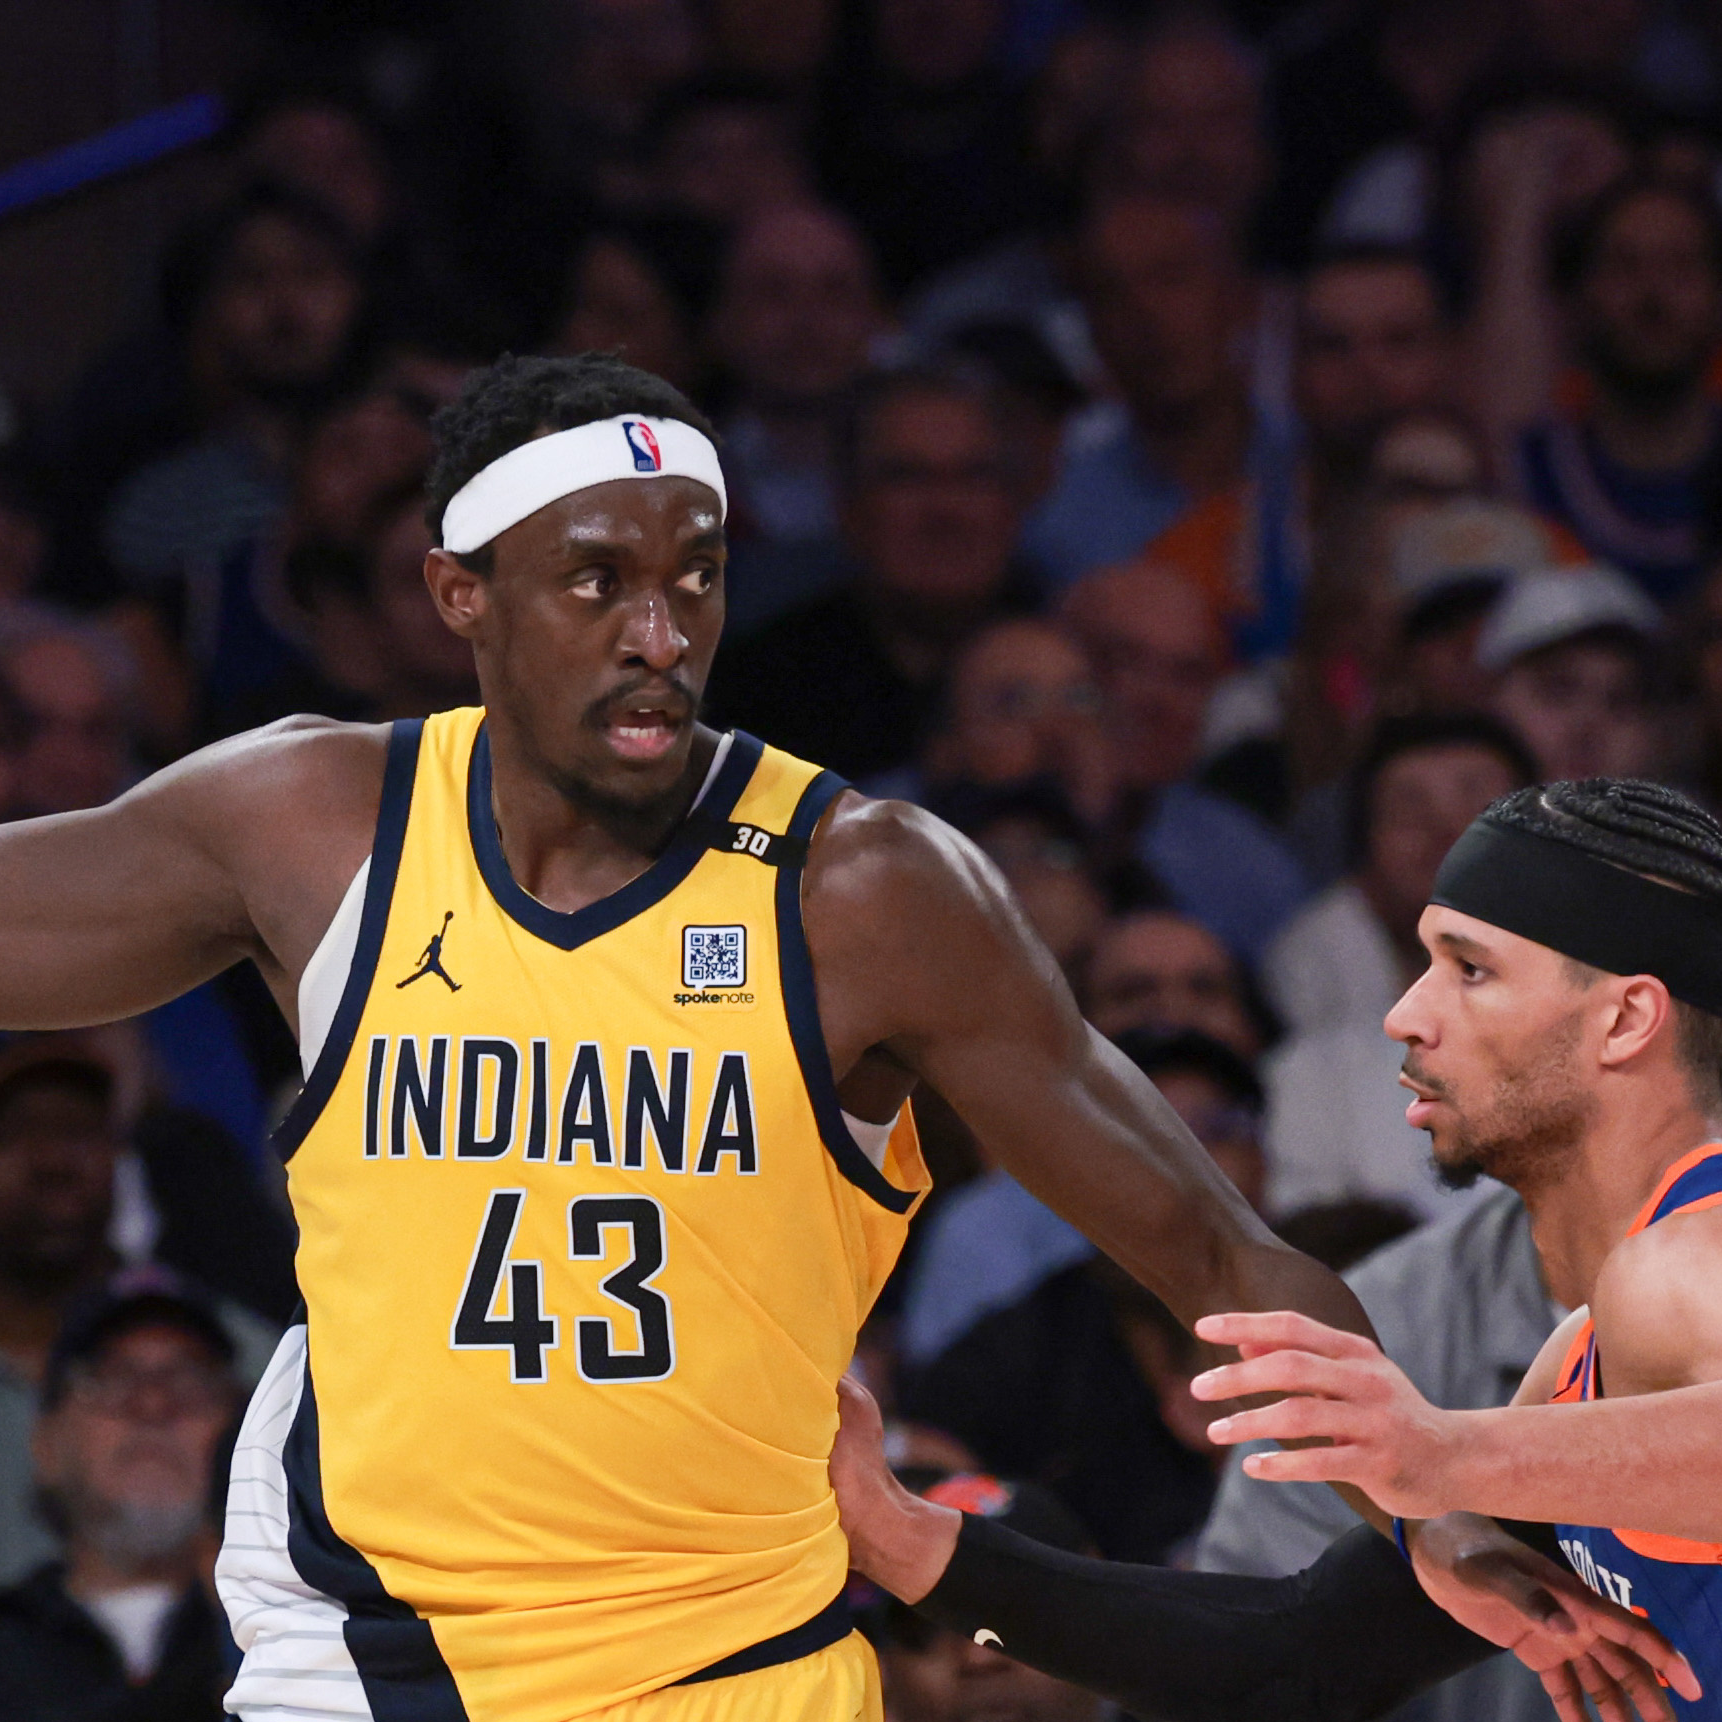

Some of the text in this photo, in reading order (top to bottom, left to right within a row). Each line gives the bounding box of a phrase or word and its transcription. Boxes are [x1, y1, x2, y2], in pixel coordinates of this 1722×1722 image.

[732, 826, 771, 857] 30
[673, 989, 755, 1007] spokenote
[363, 1034, 760, 1176] INDIANA
[450, 1187, 677, 1384] 43
